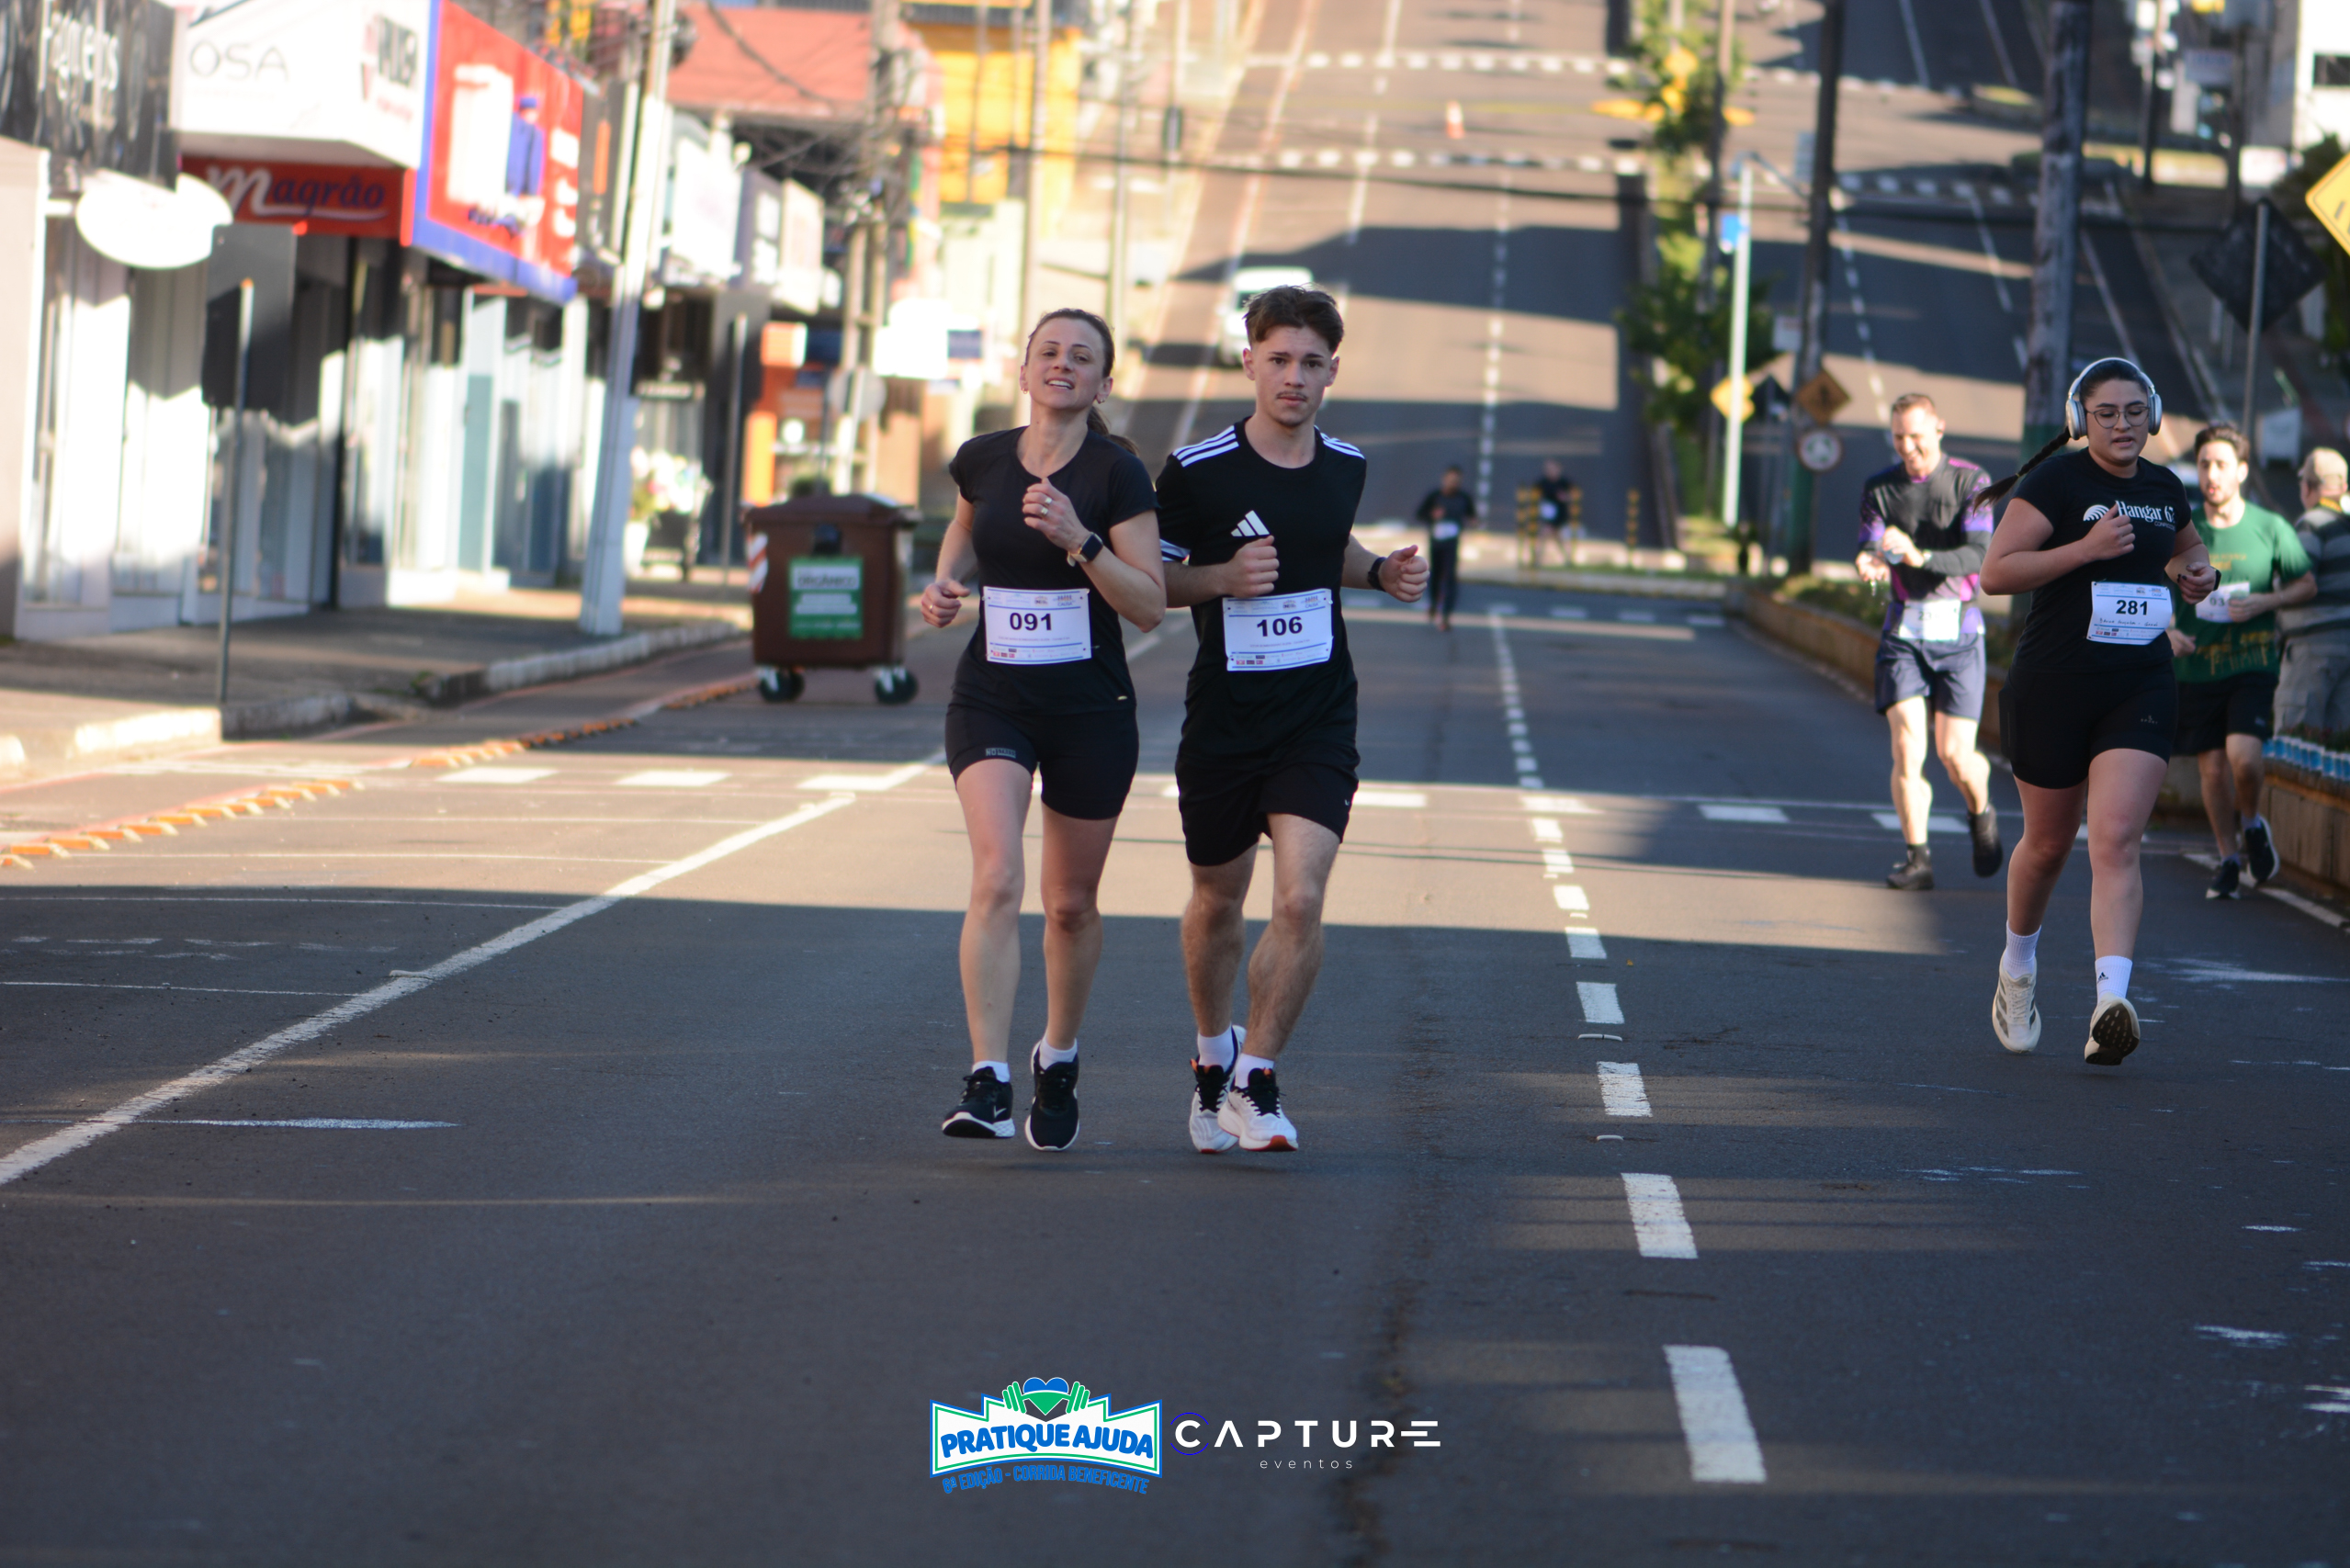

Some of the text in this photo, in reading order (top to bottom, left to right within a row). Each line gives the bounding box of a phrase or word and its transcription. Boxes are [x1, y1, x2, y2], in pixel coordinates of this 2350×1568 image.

[2115, 500, 2163, 523] Hangar
[2116, 599, 2148, 615] 281
[2209, 597, 2225, 606] 03
[1010, 613, 1052, 631] 091
[1257, 616, 1303, 637] 106
